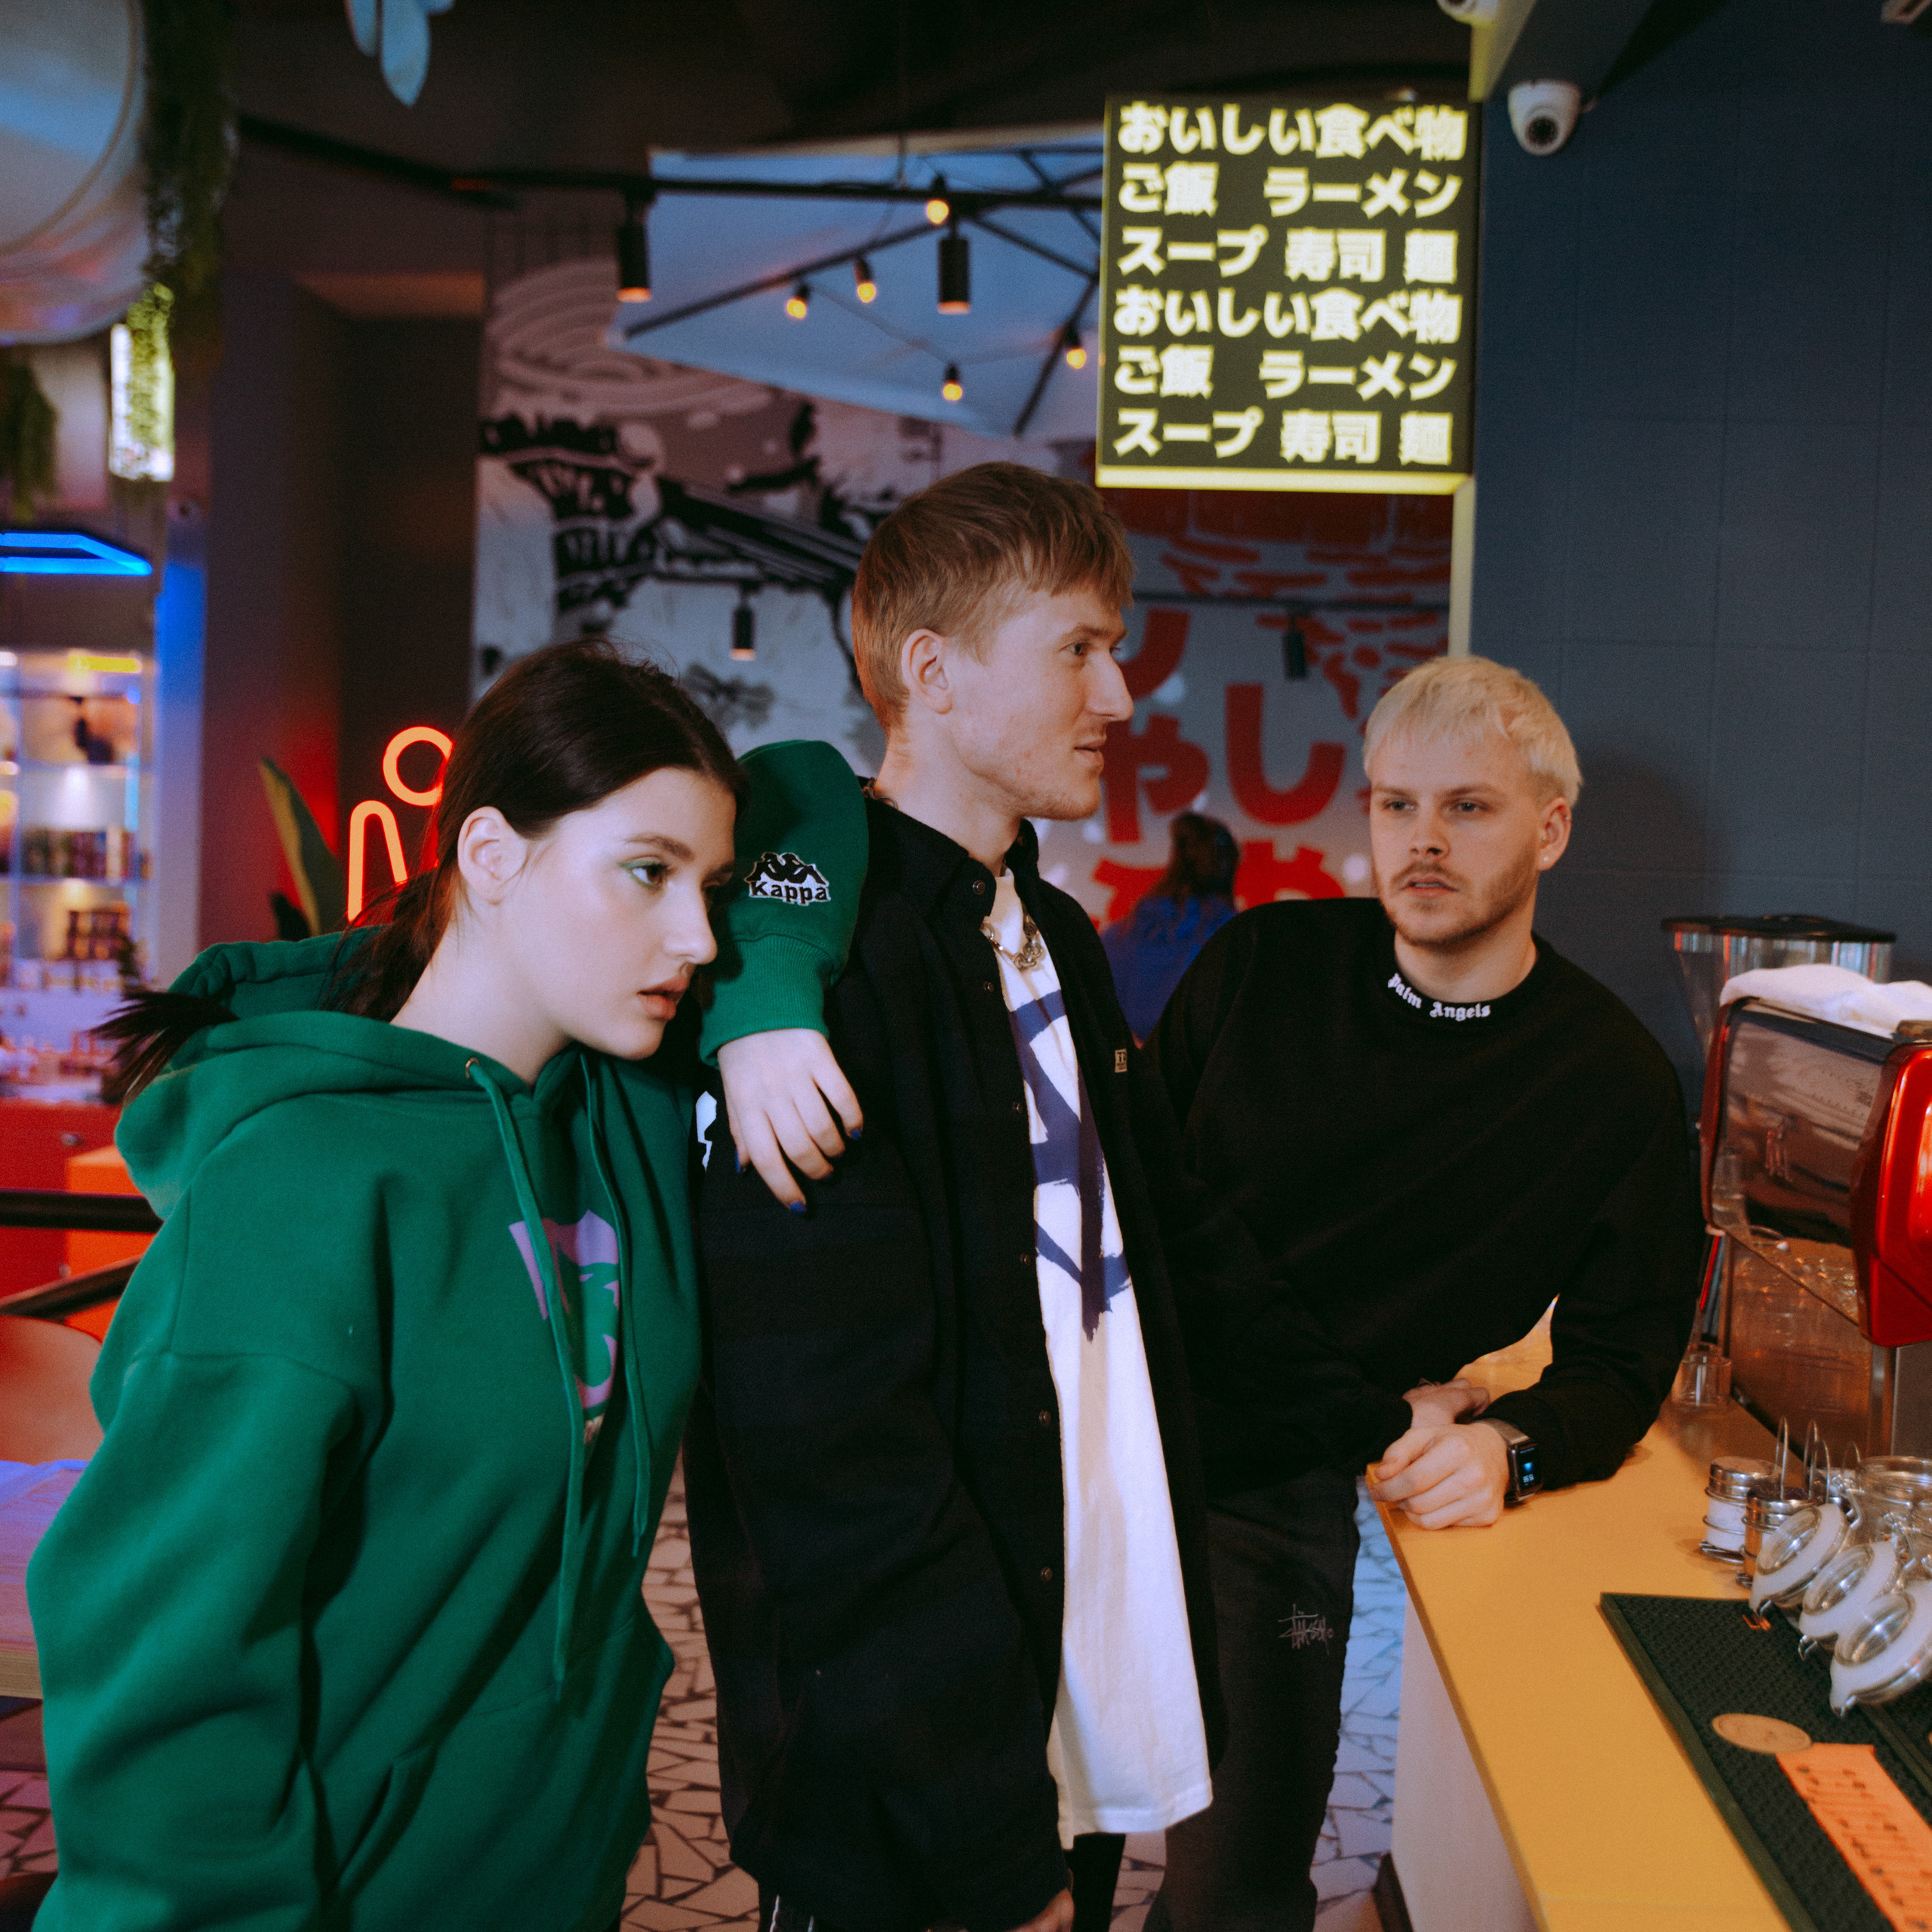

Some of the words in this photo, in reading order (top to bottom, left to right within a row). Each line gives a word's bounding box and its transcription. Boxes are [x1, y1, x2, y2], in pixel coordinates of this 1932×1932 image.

[1118, 101, 1468, 161] おいしい食べ物
[1118, 161, 1219, 217] ご飯
[1263, 167, 1462, 219] ラーメン
[1118, 224, 1269, 277] スープ
[1284, 226, 1386, 282] 寿司
[1113, 285, 1463, 344] おいしい食べ物
[1114, 344, 1214, 399] ご飯
[1259, 350, 1457, 401] ラーメン
[1113, 406, 1265, 458] スープ
[1280, 408, 1382, 463] 寿司
[751, 881, 829, 904] Kappa
[1387, 973, 1422, 1008] Palm
[1429, 1001, 1491, 1022] Angels
